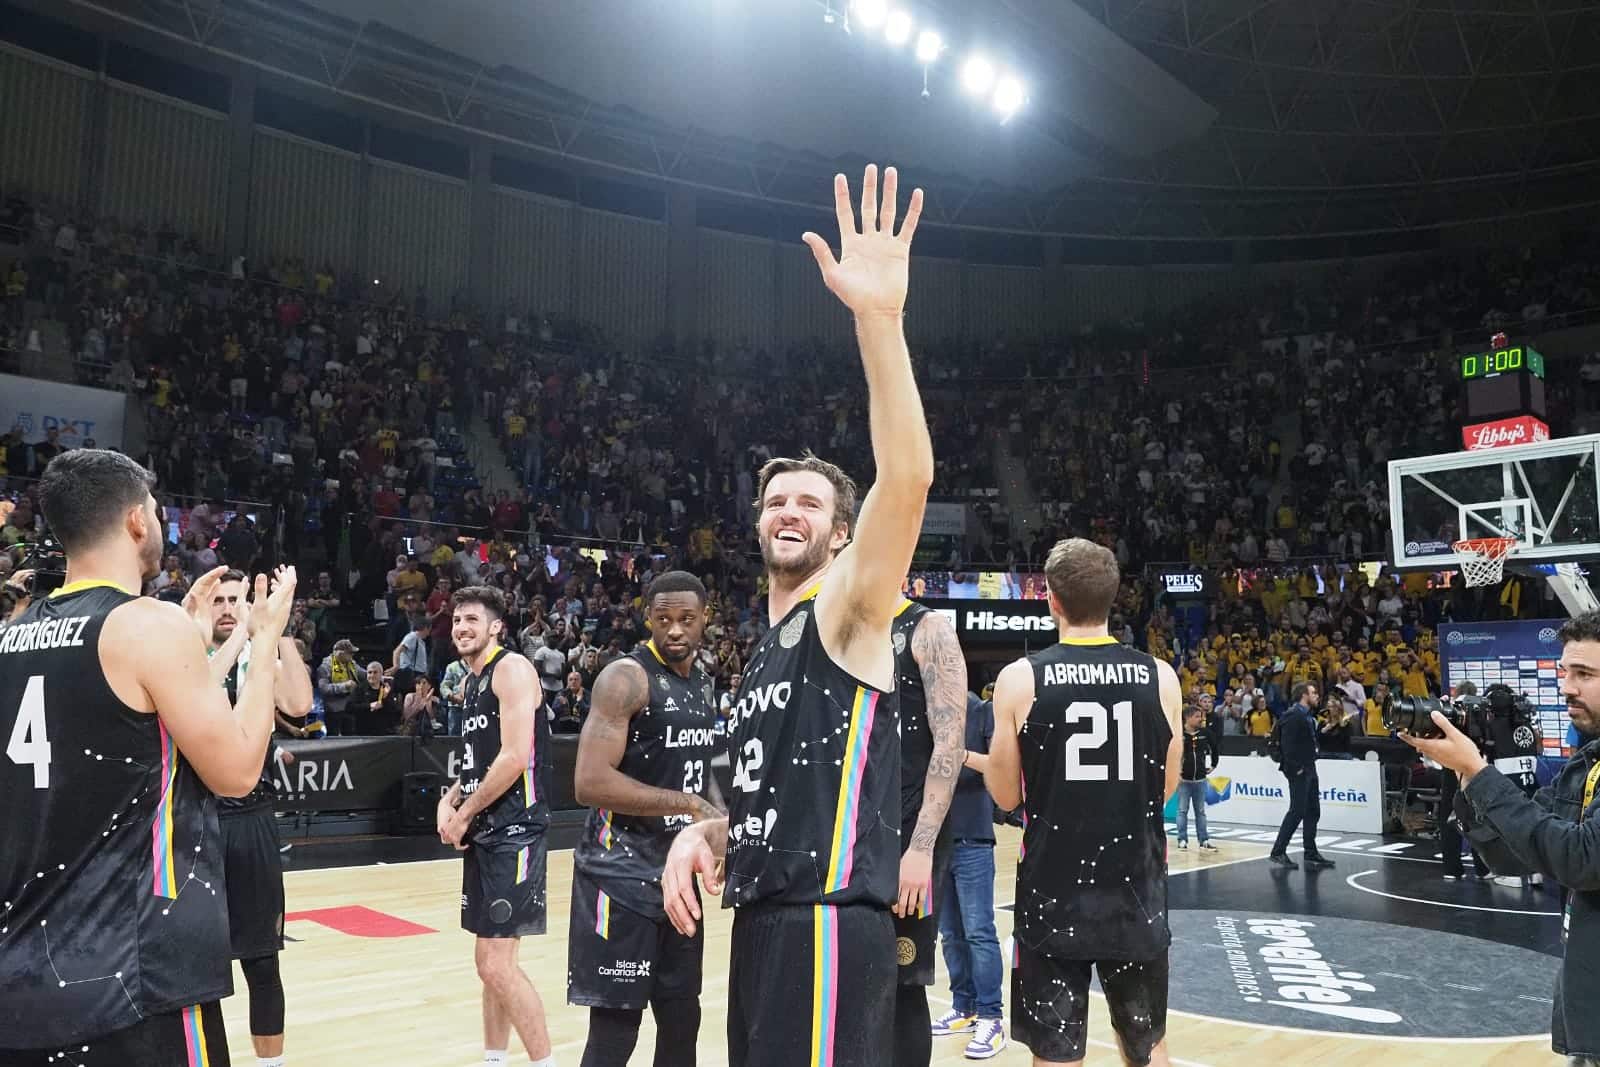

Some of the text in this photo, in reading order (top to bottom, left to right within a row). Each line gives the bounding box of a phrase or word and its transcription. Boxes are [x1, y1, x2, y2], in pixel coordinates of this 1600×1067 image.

[1472, 425, 1526, 449] Libby's
[0, 616, 91, 654] RODRÍGUEZ
[966, 611, 1056, 631] Hisens
[1044, 663, 1150, 686] ABROMAITIS
[727, 681, 792, 738] enovo
[6, 675, 51, 788] 4
[1065, 701, 1134, 781] 21
[683, 760, 703, 793] 23
[1235, 783, 1367, 803] Mutua erfeña
[598, 967, 636, 977] Canarias
[616, 960, 637, 969] Islas
[1226, 949, 1263, 996] emociones
[1244, 918, 1402, 1023] tenerife!
